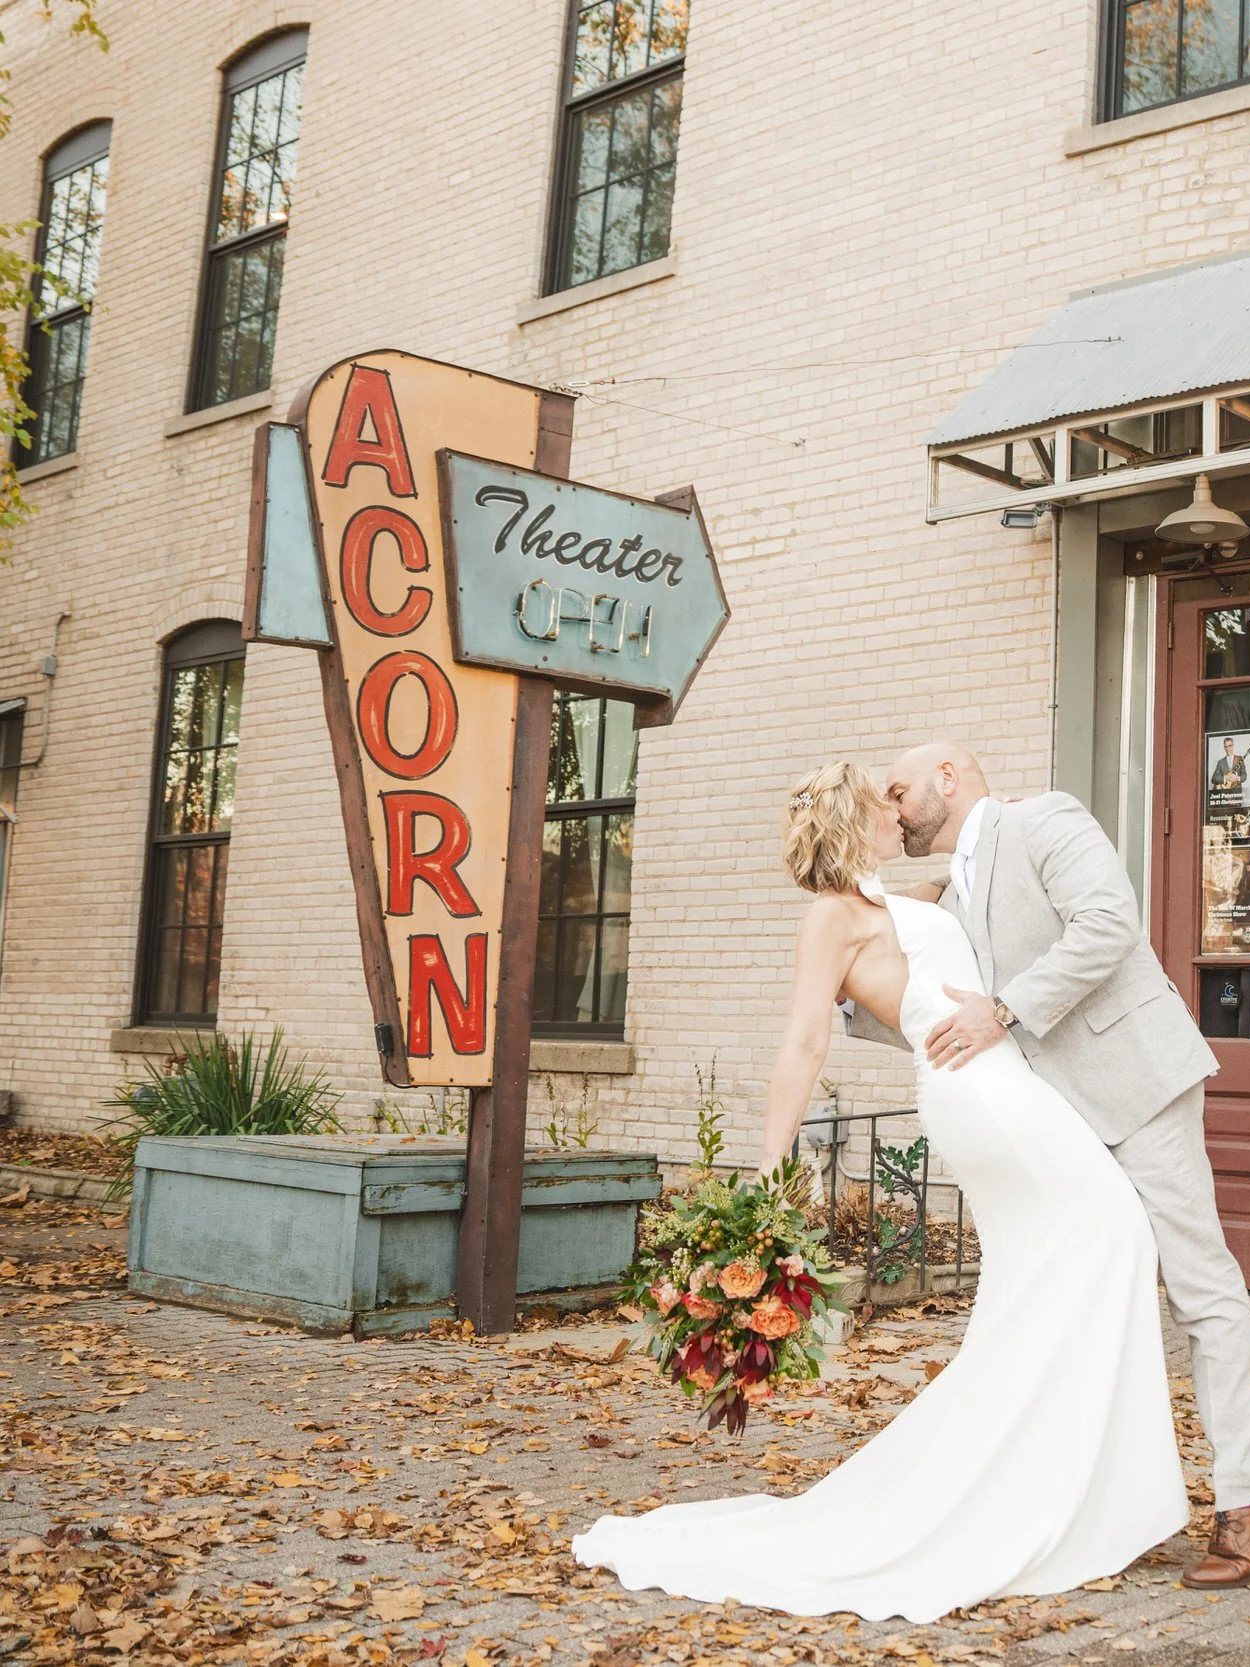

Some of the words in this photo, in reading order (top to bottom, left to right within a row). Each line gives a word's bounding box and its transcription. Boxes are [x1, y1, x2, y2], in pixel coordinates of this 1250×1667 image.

[474, 484, 684, 587] Theater
[512, 578, 653, 659] OPEN
[321, 362, 488, 1058] ACORN
